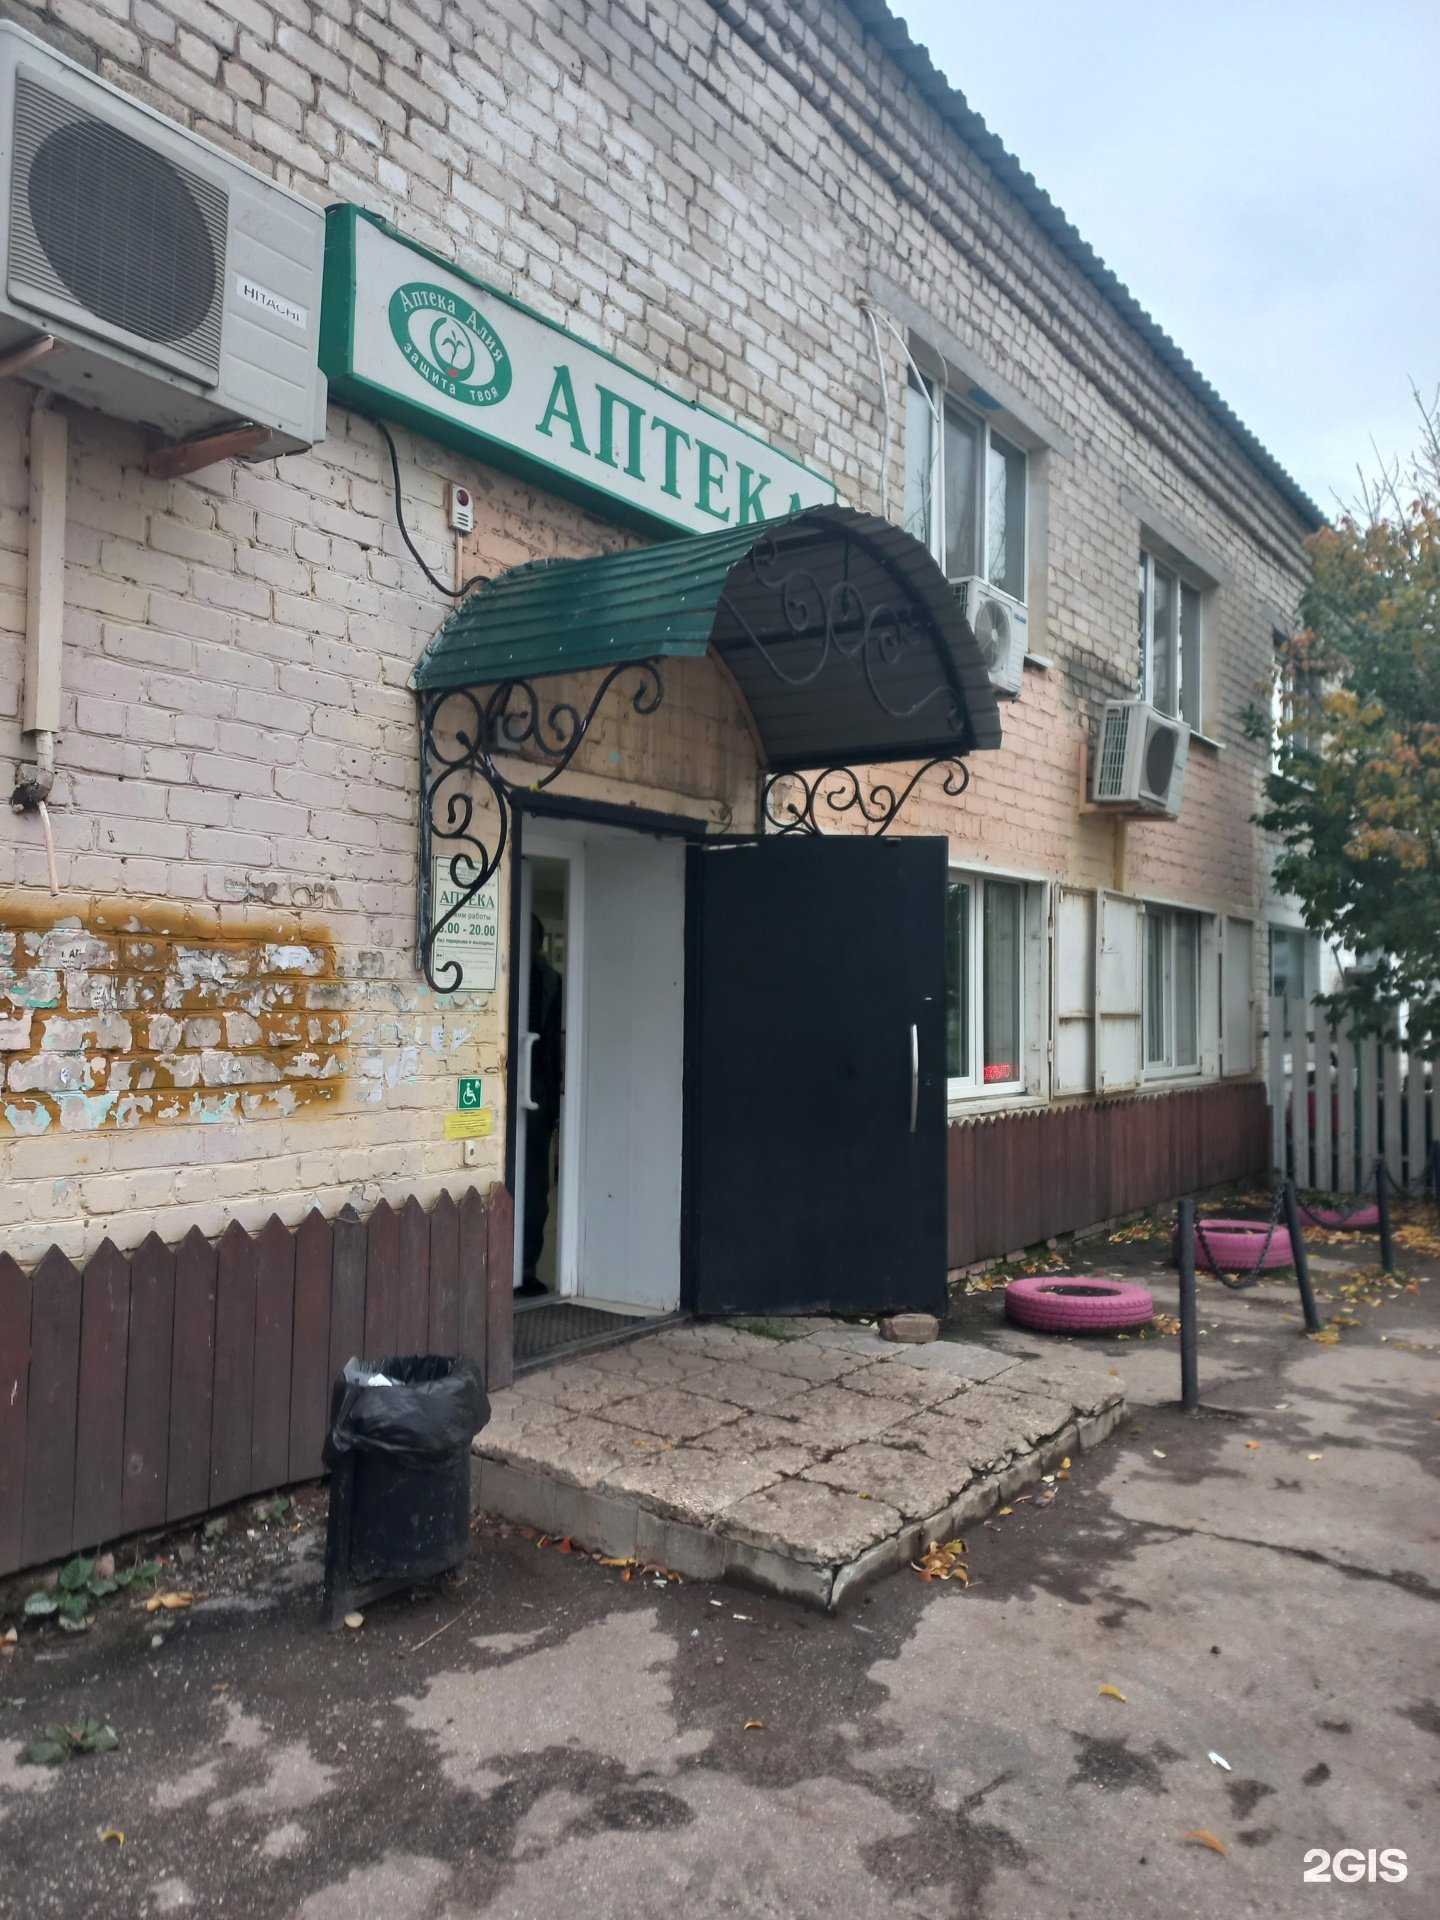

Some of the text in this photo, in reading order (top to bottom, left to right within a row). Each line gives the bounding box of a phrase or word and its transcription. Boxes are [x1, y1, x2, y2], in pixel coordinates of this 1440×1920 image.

[244, 284, 299, 321] HITACHI
[400, 290, 503, 361] Аптека Алия
[404, 343, 498, 401] защита твоя
[440, 890, 495, 909] АПЕКА
[469, 923, 495, 936] 20.00
